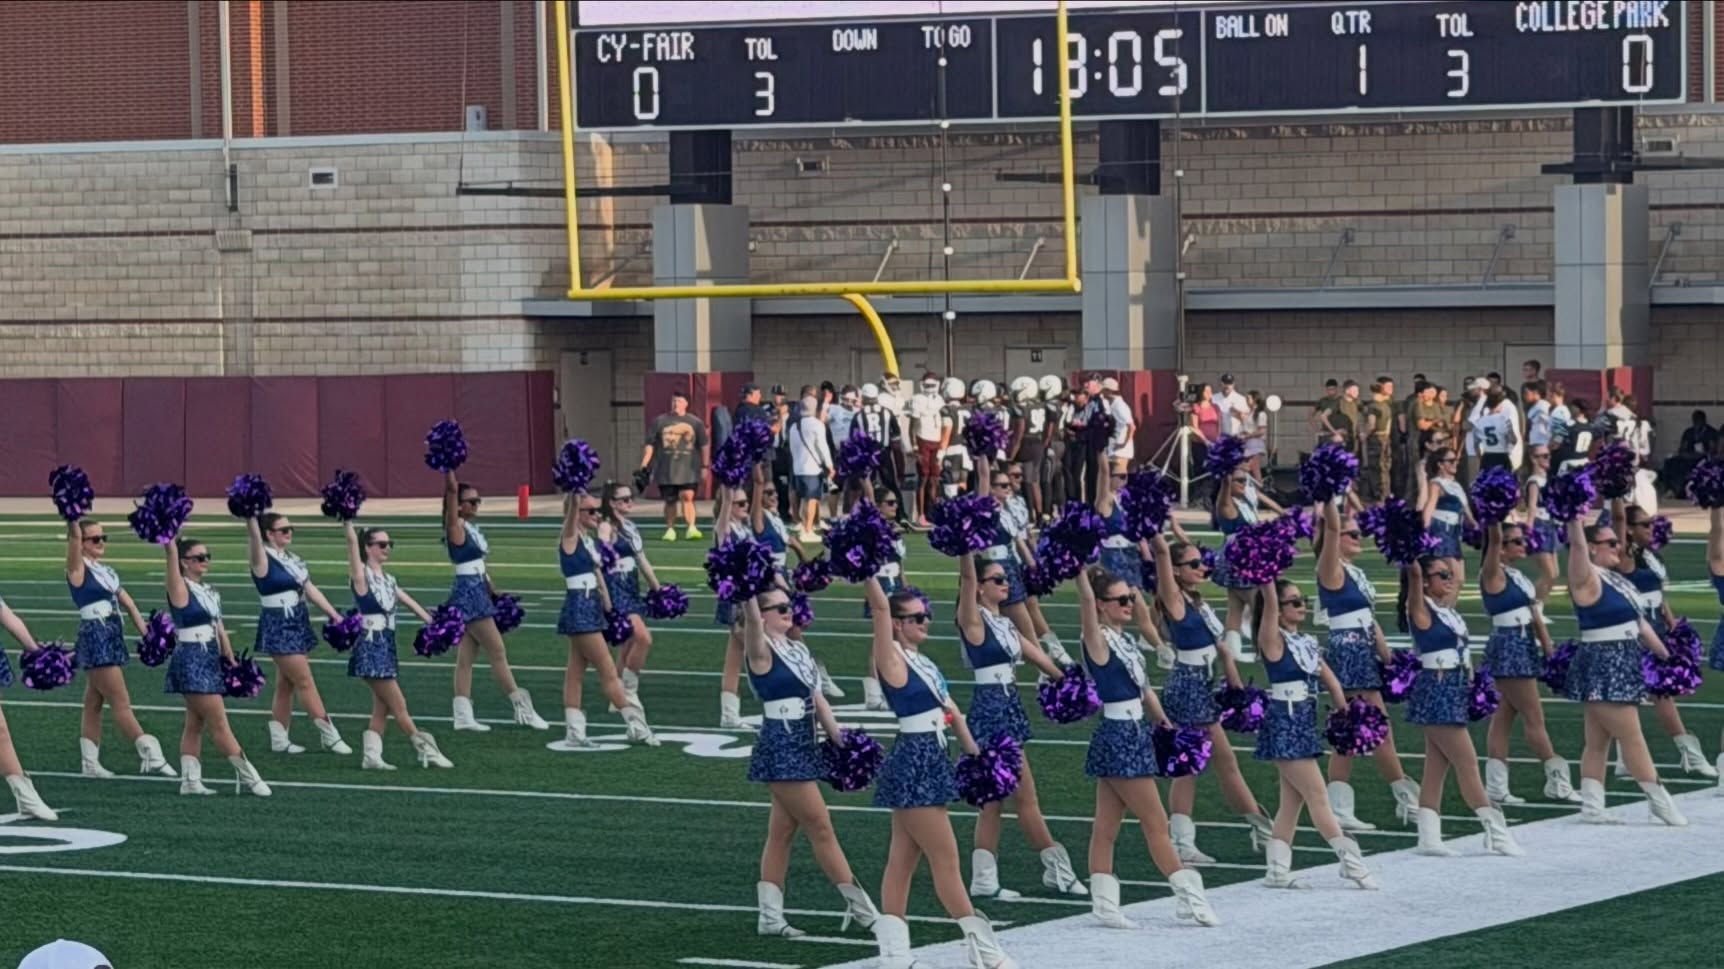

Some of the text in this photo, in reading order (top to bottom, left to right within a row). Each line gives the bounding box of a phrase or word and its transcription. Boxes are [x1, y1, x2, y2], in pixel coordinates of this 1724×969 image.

[1215, 13, 1288, 39] BALL ON
[1331, 10, 1372, 35] QTR
[1436, 13, 1474, 37] TOL
[1515, 0, 1669, 32] COLLEGE PARK
[597, 31, 695, 62] CY-FAIR
[744, 37, 778, 60] TOL
[832, 28, 878, 52] DOWN
[921, 24, 971, 49] TO GO
[1359, 44, 1368, 95] 1
[1447, 50, 1470, 98] 3
[1623, 34, 1654, 93] 0
[633, 67, 660, 120] 0
[754, 72, 776, 117] 3
[1484, 426, 1499, 447] 5
